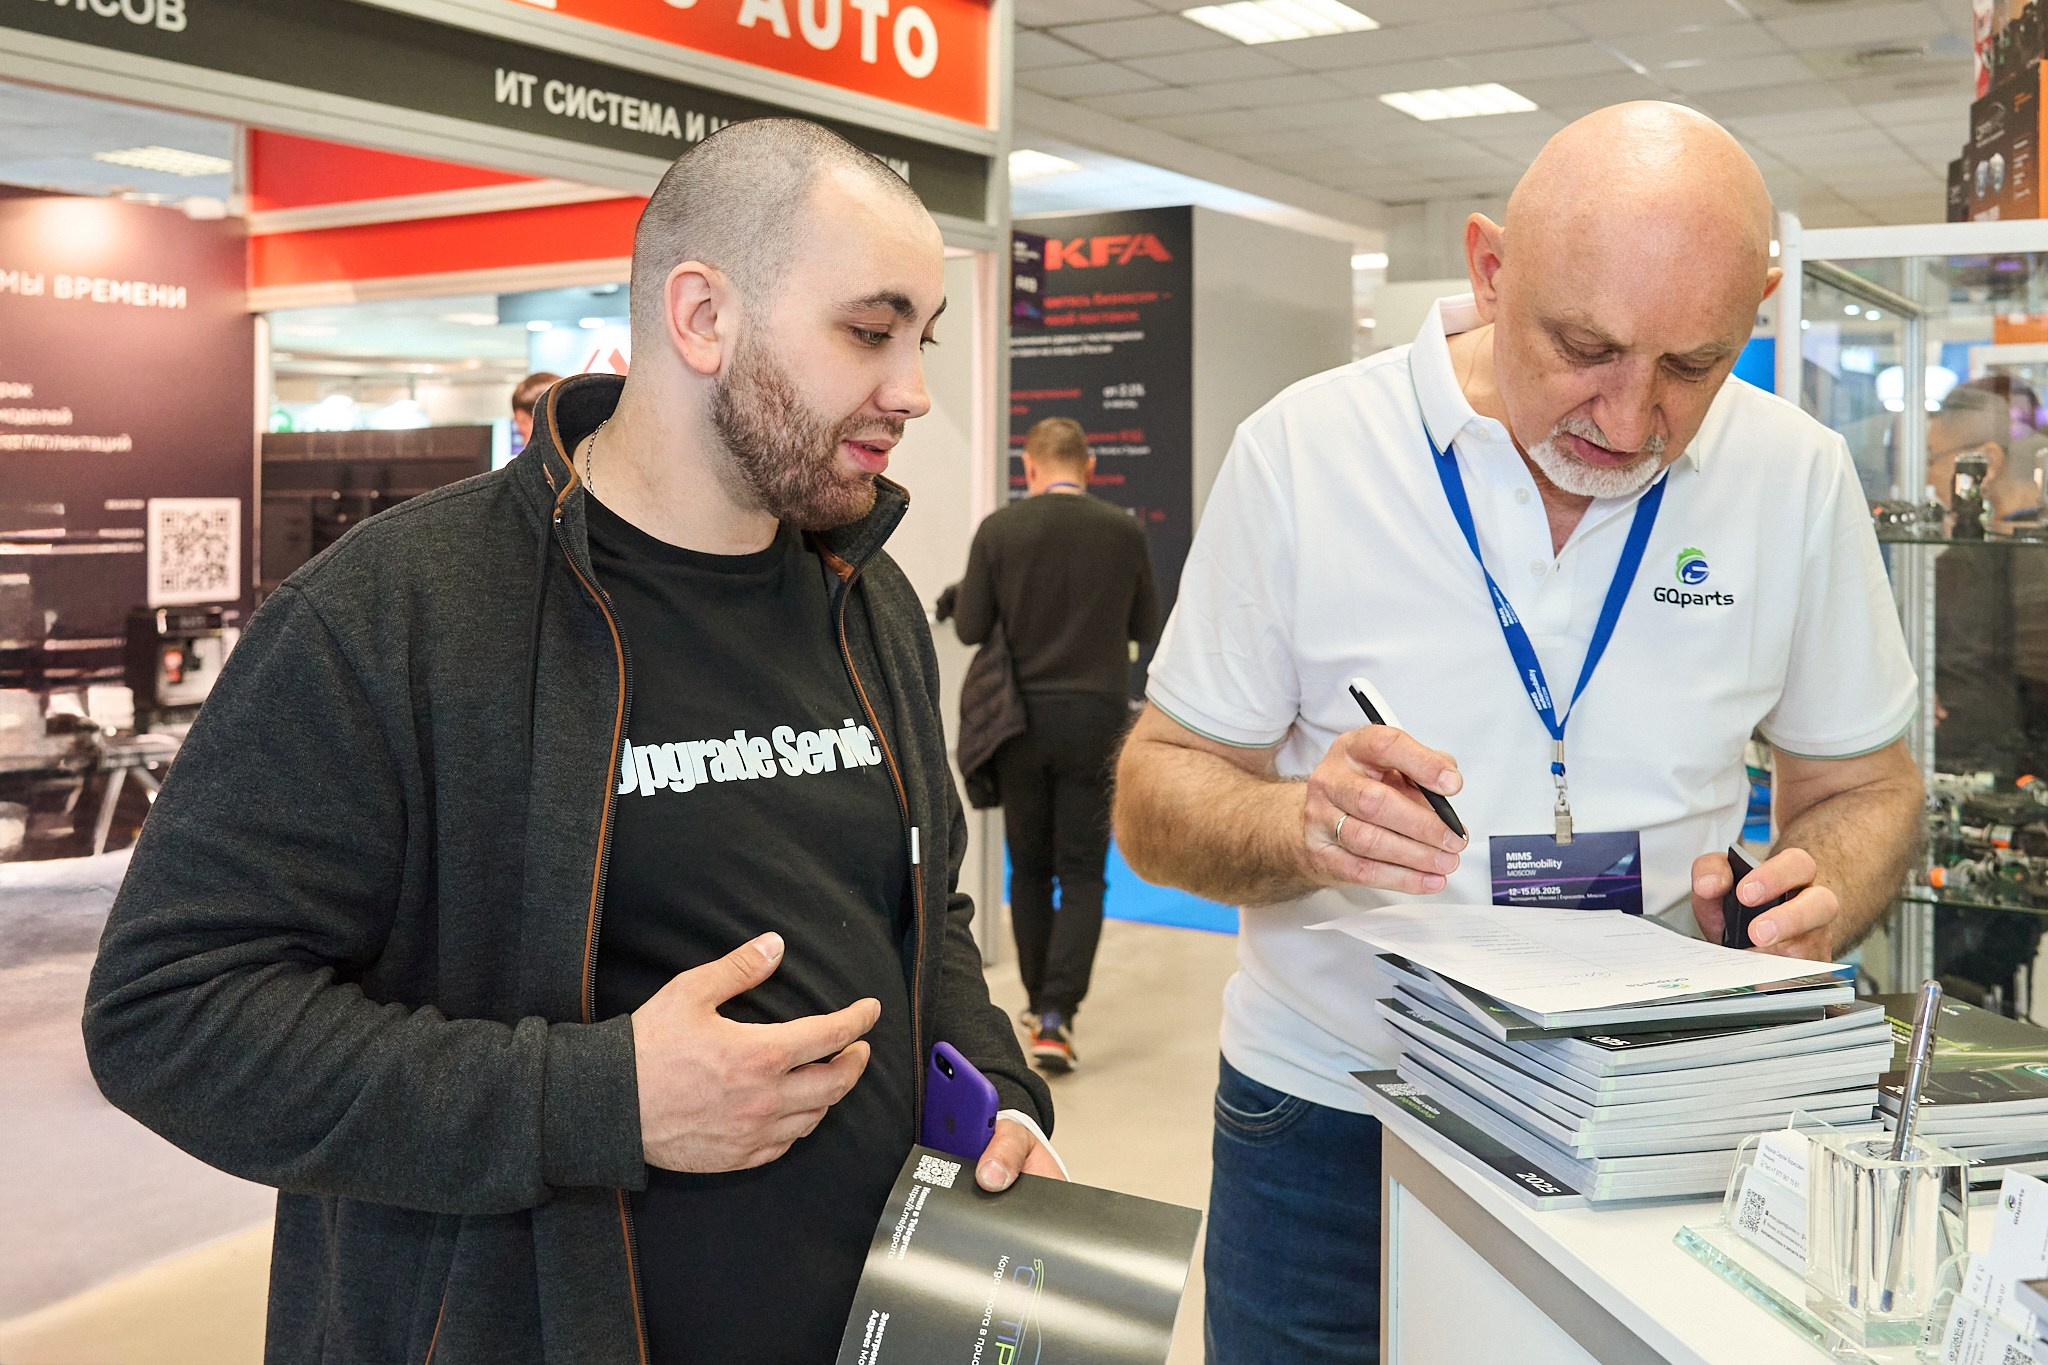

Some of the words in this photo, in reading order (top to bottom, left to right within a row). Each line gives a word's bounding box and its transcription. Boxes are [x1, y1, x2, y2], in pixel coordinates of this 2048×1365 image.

[495, 68, 537, 107] ИТ
[543, 80, 681, 140] СИСТЕМА
[53, 274, 187, 309] ВРЕМЕНИ
[1653, 586, 1735, 609] GQparts
[1506, 852, 1532, 862] MIMS
[1507, 859, 1562, 870] automobility
[1507, 869, 1536, 877] MOSCOW
[1515, 1171, 1562, 1194] 2025
